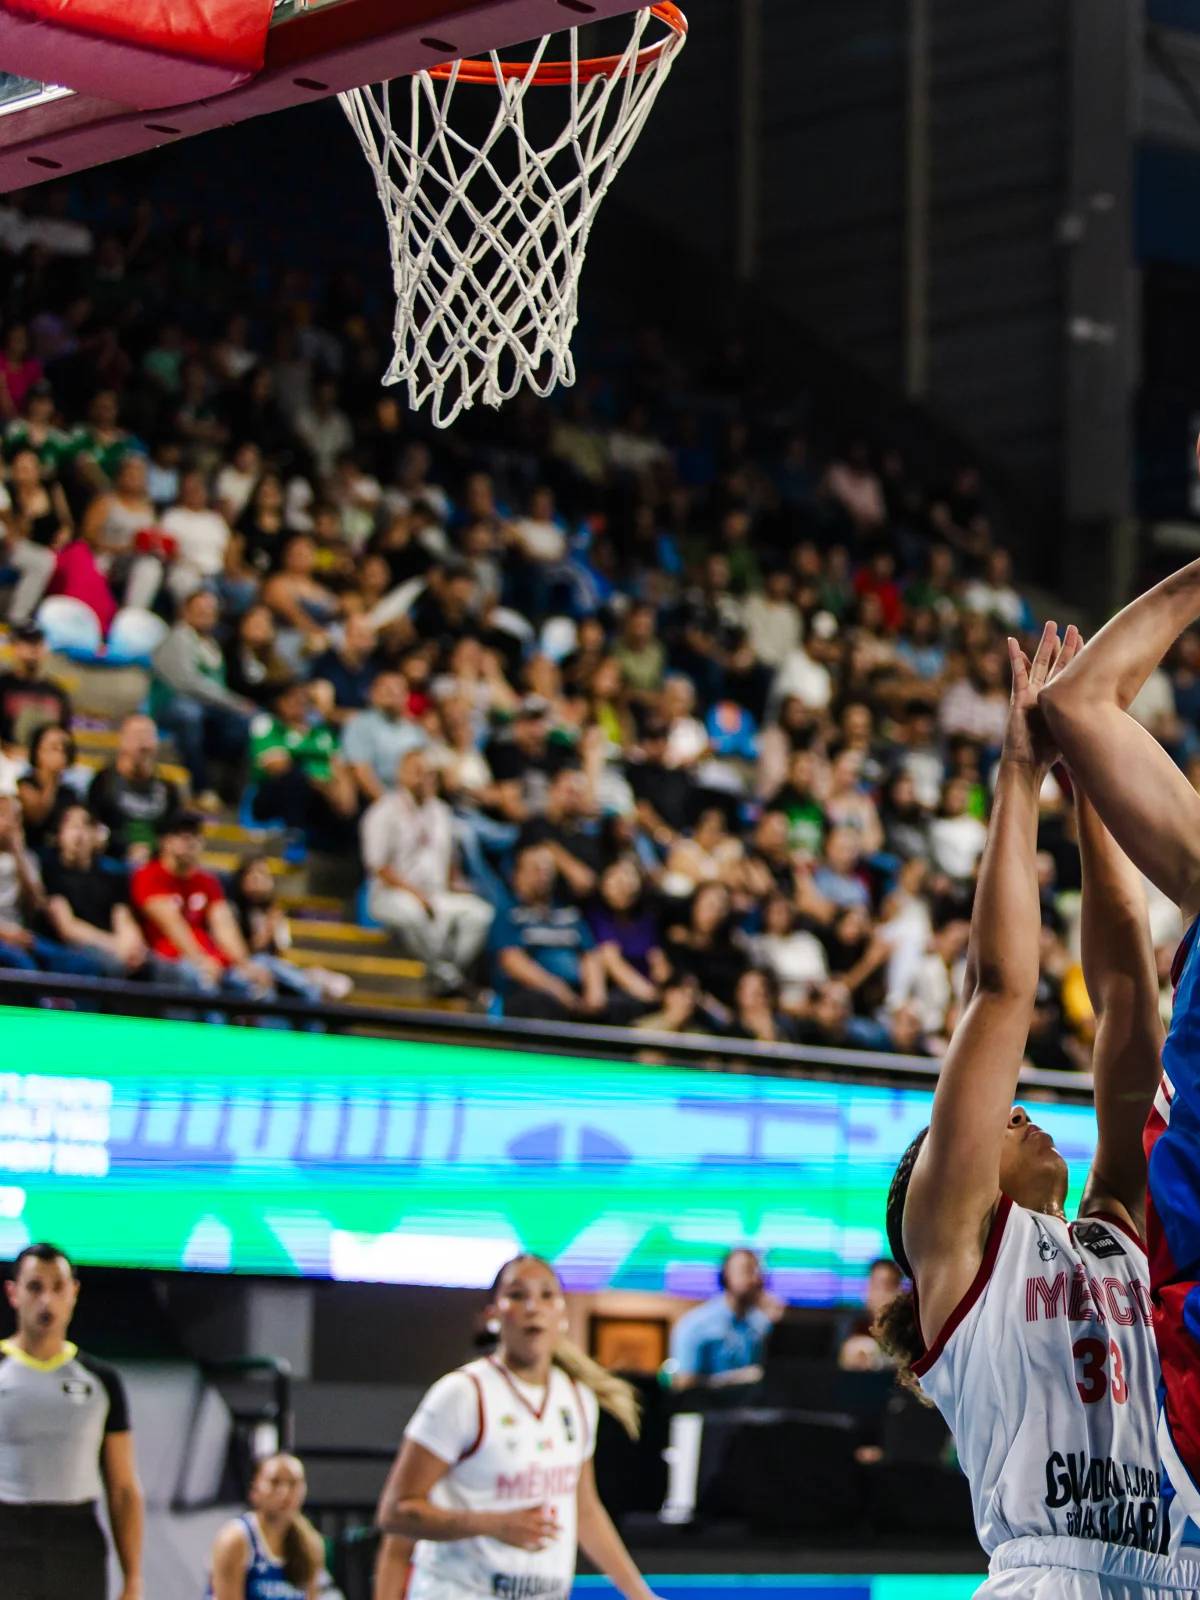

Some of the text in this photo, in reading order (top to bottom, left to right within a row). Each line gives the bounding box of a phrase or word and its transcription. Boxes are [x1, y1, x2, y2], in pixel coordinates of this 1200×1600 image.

[1091, 1238, 1114, 1250] FIBA
[1026, 1263, 1154, 1327] MÉXCO
[1072, 1338, 1129, 1405] 33
[495, 1463, 578, 1500] MÉXIC
